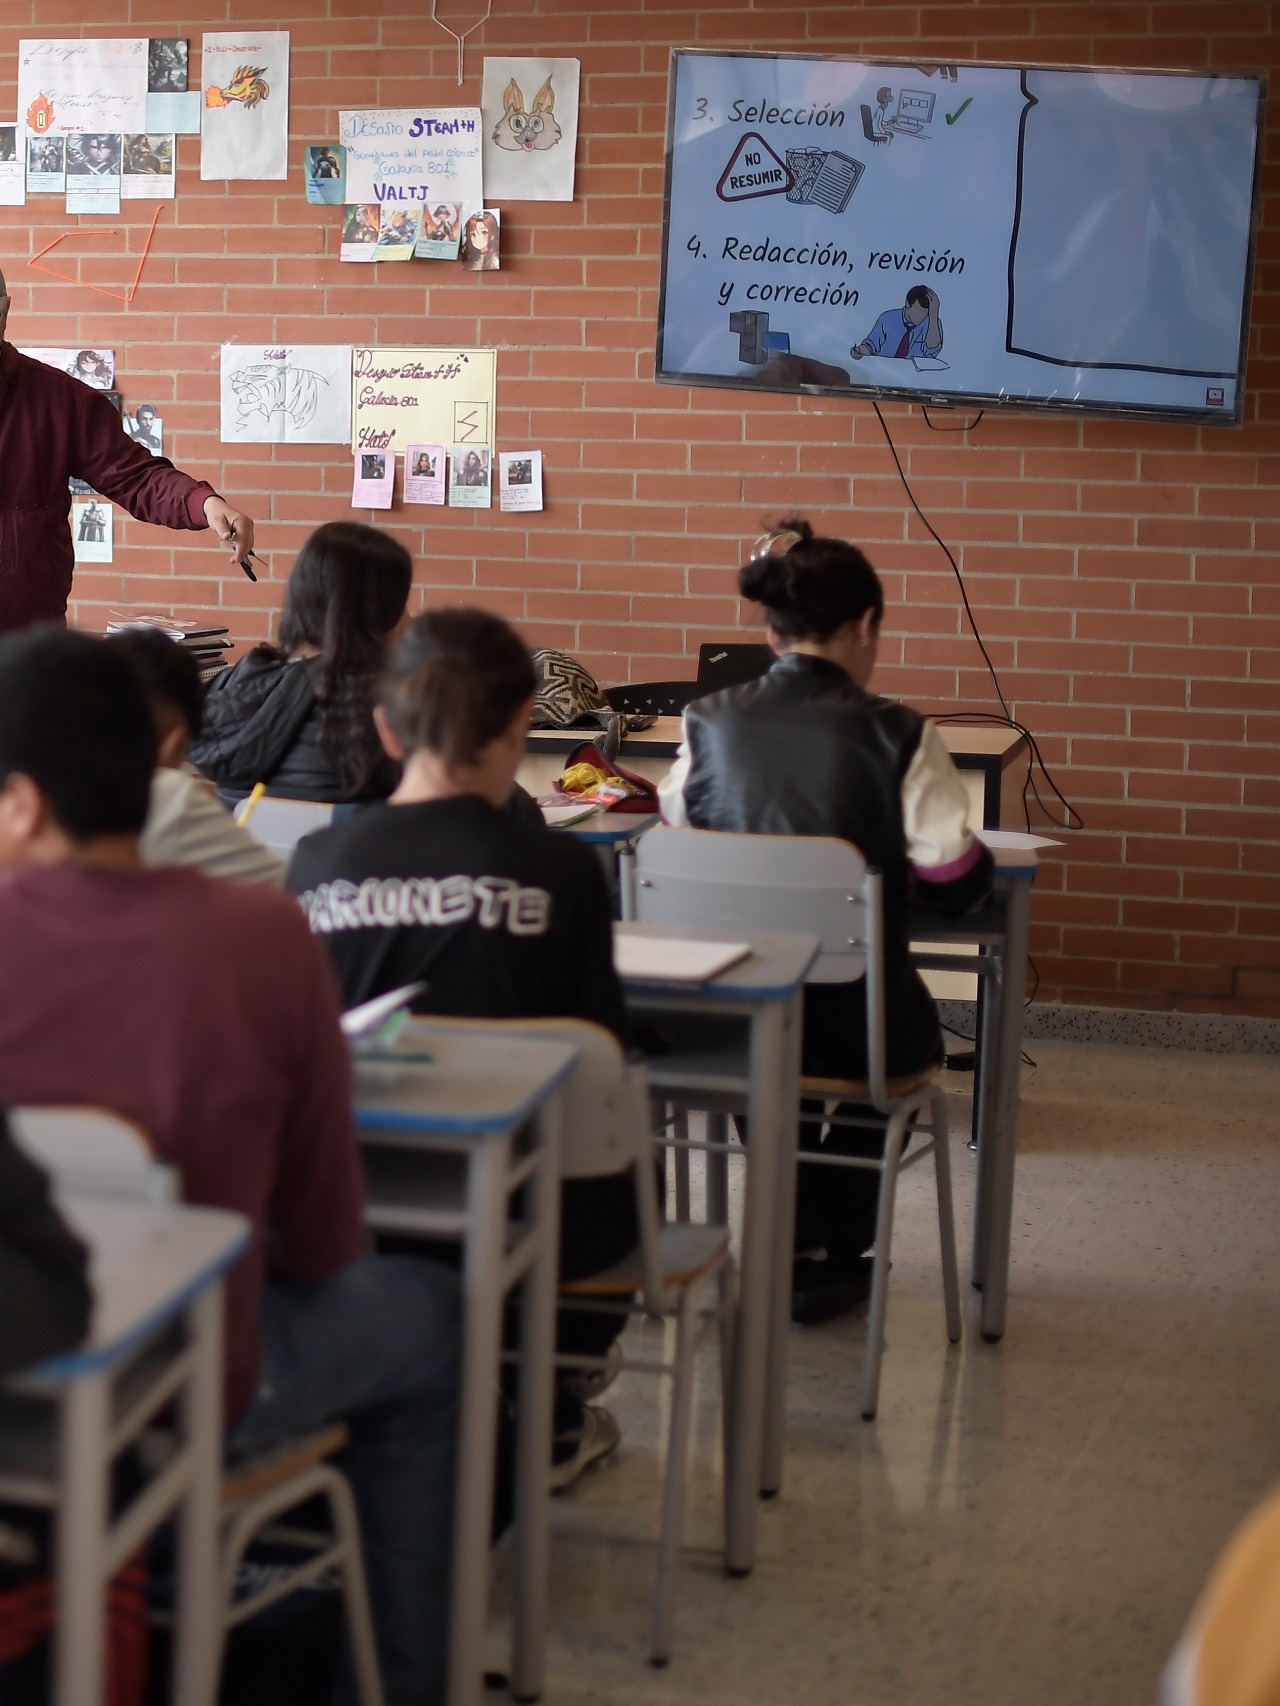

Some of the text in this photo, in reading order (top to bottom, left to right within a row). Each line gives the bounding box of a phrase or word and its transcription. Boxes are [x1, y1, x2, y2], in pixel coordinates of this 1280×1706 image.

[692, 97, 845, 127] 3. Selección
[745, 152, 761, 167] NO
[730, 168, 783, 190] RESUMIR
[687, 234, 965, 275] 4. Redacción, revisión
[718, 281, 860, 307] y correción
